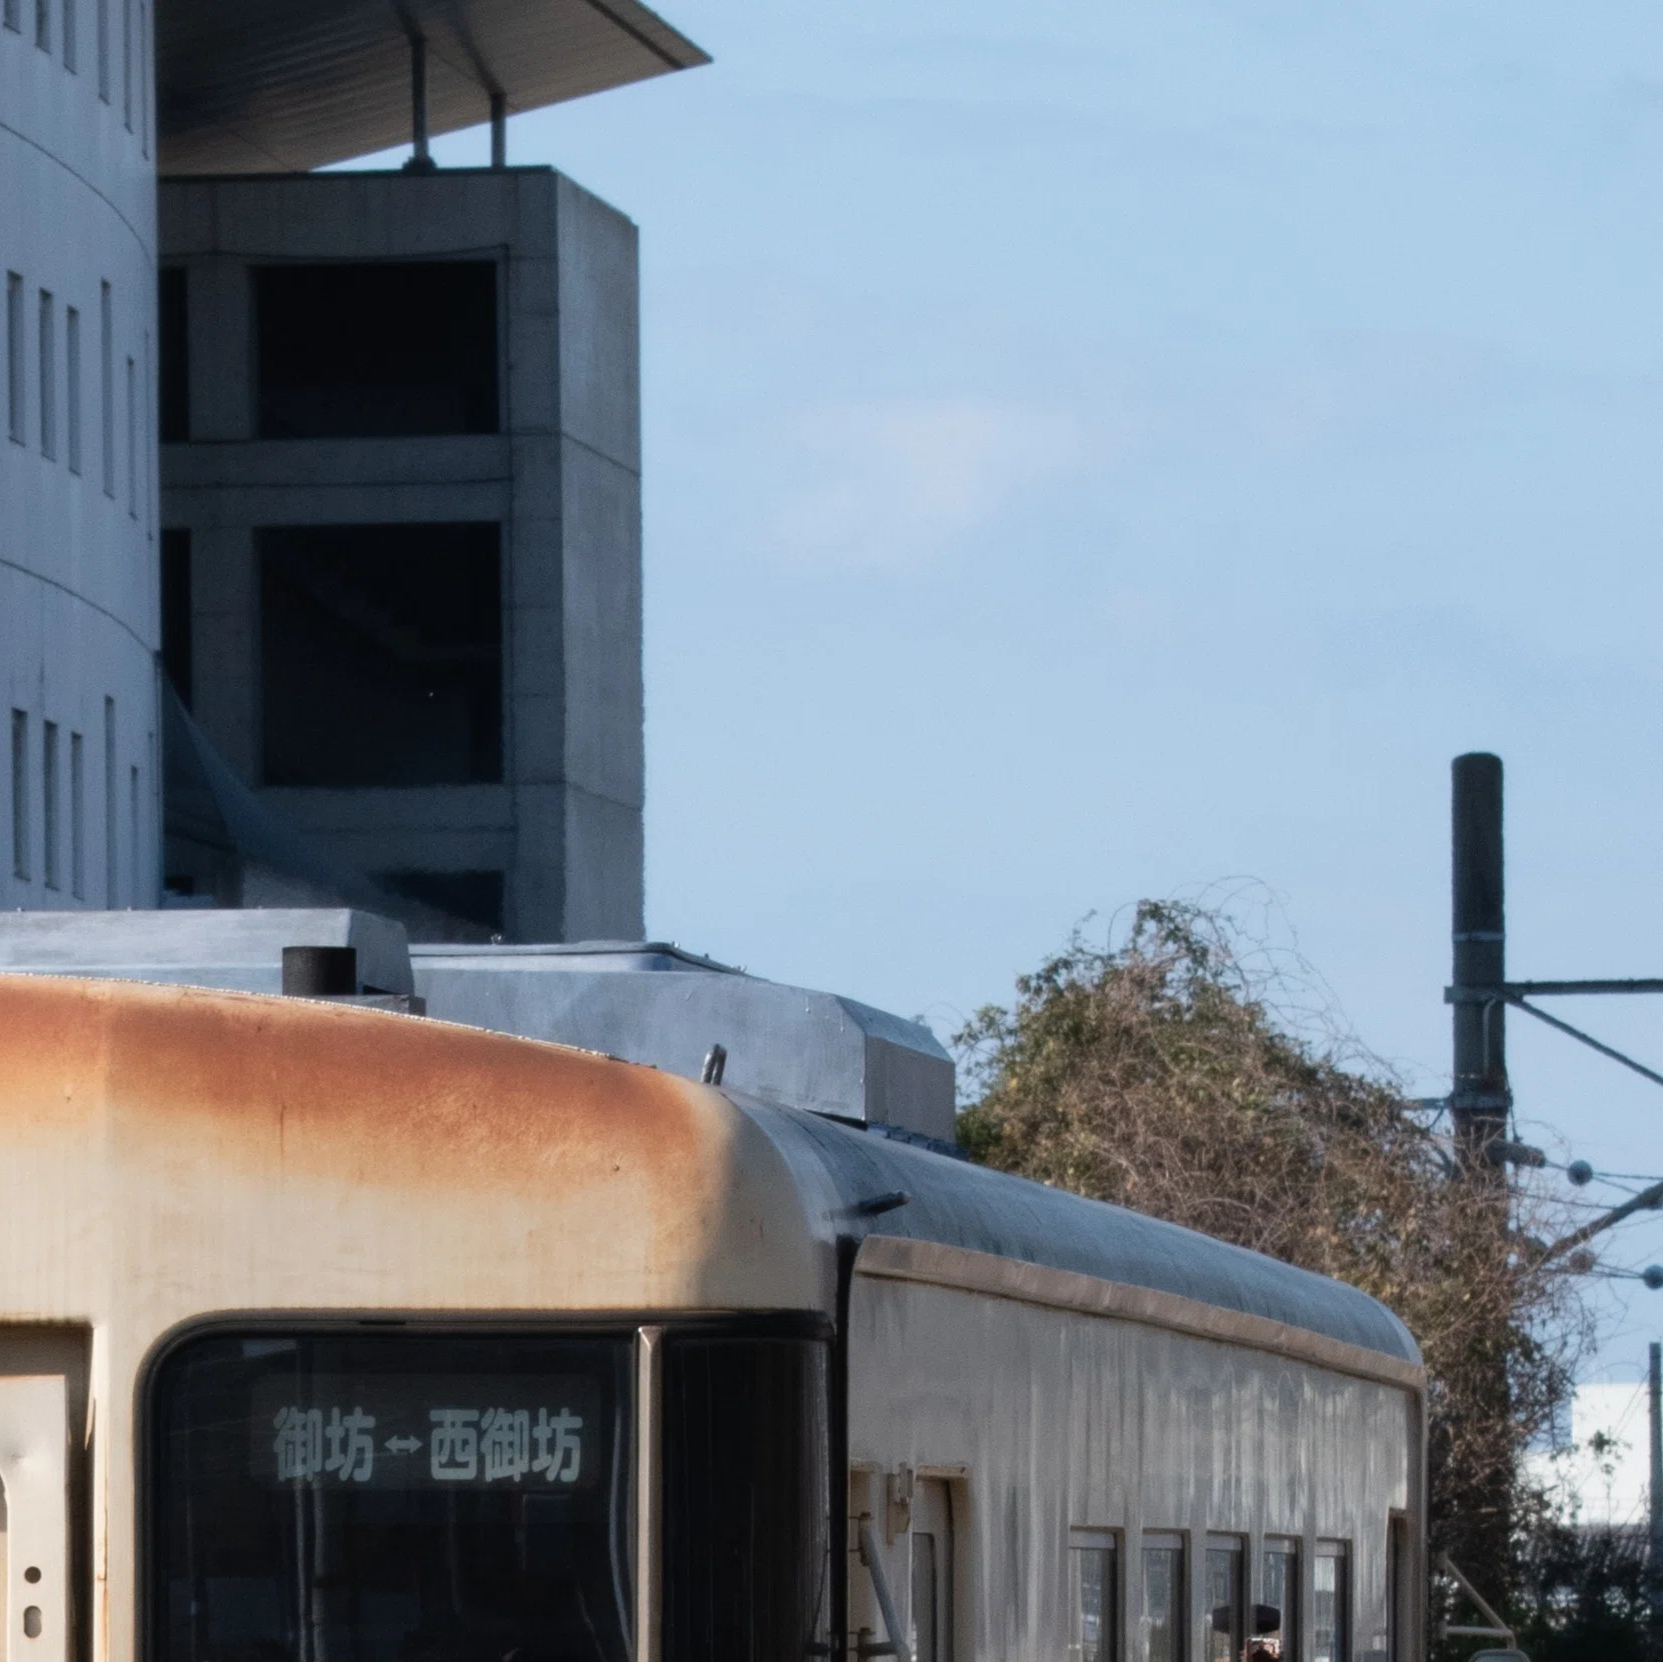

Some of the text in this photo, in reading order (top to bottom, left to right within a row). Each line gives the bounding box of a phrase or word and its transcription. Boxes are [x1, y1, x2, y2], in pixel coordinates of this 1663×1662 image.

[273, 1406, 583, 1482] 御坊 西御坊
